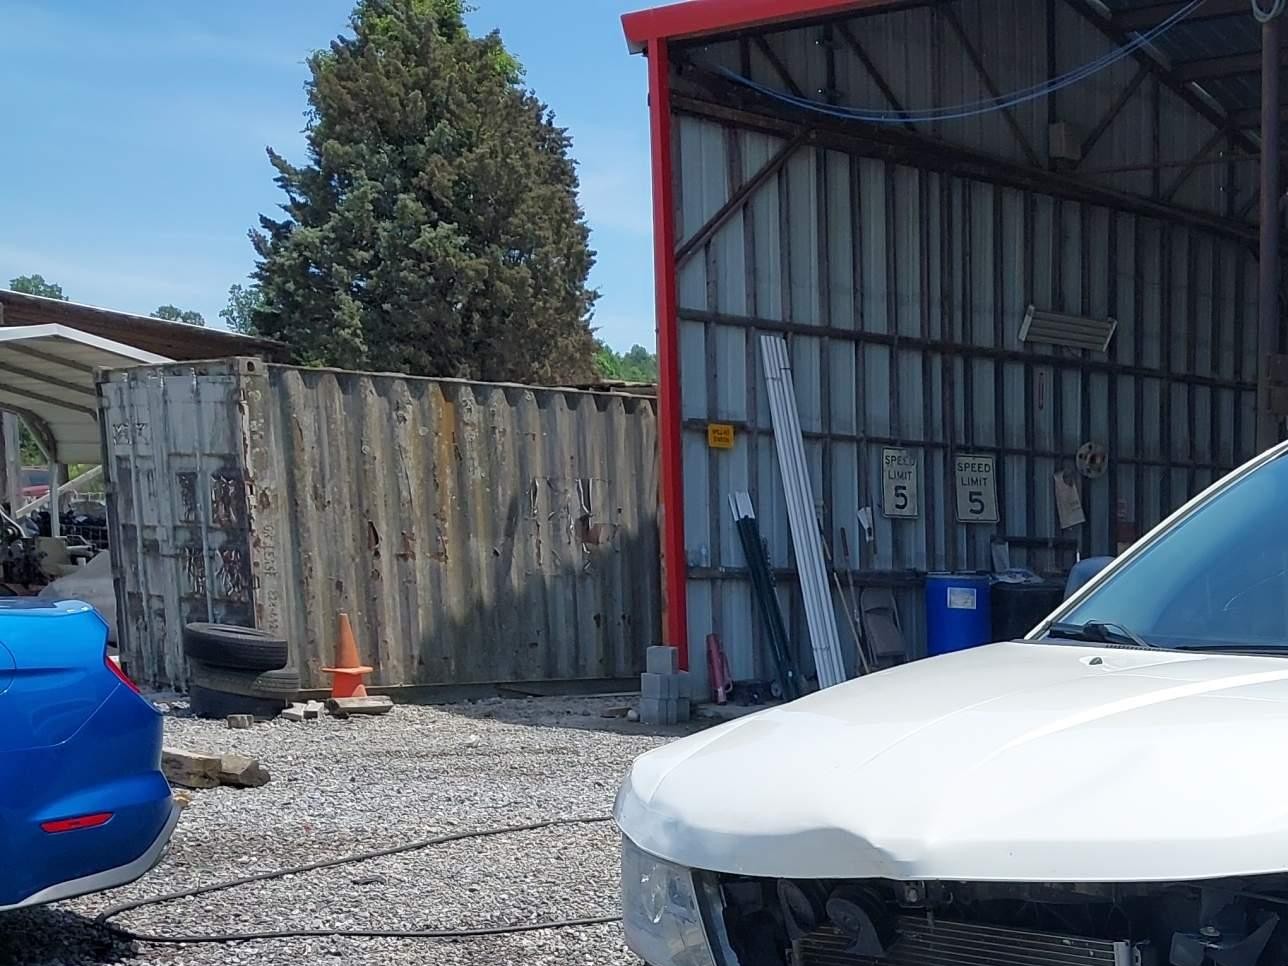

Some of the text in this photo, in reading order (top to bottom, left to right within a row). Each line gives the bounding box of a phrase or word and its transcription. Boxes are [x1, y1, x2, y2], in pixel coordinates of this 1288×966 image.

[885, 455, 916, 466] SPEED
[957, 462, 991, 473] SPEED
[888, 471, 912, 481] LIMIT
[961, 477, 988, 487] LIMIT
[894, 485, 908, 509] 5
[968, 491, 985, 514] 5
